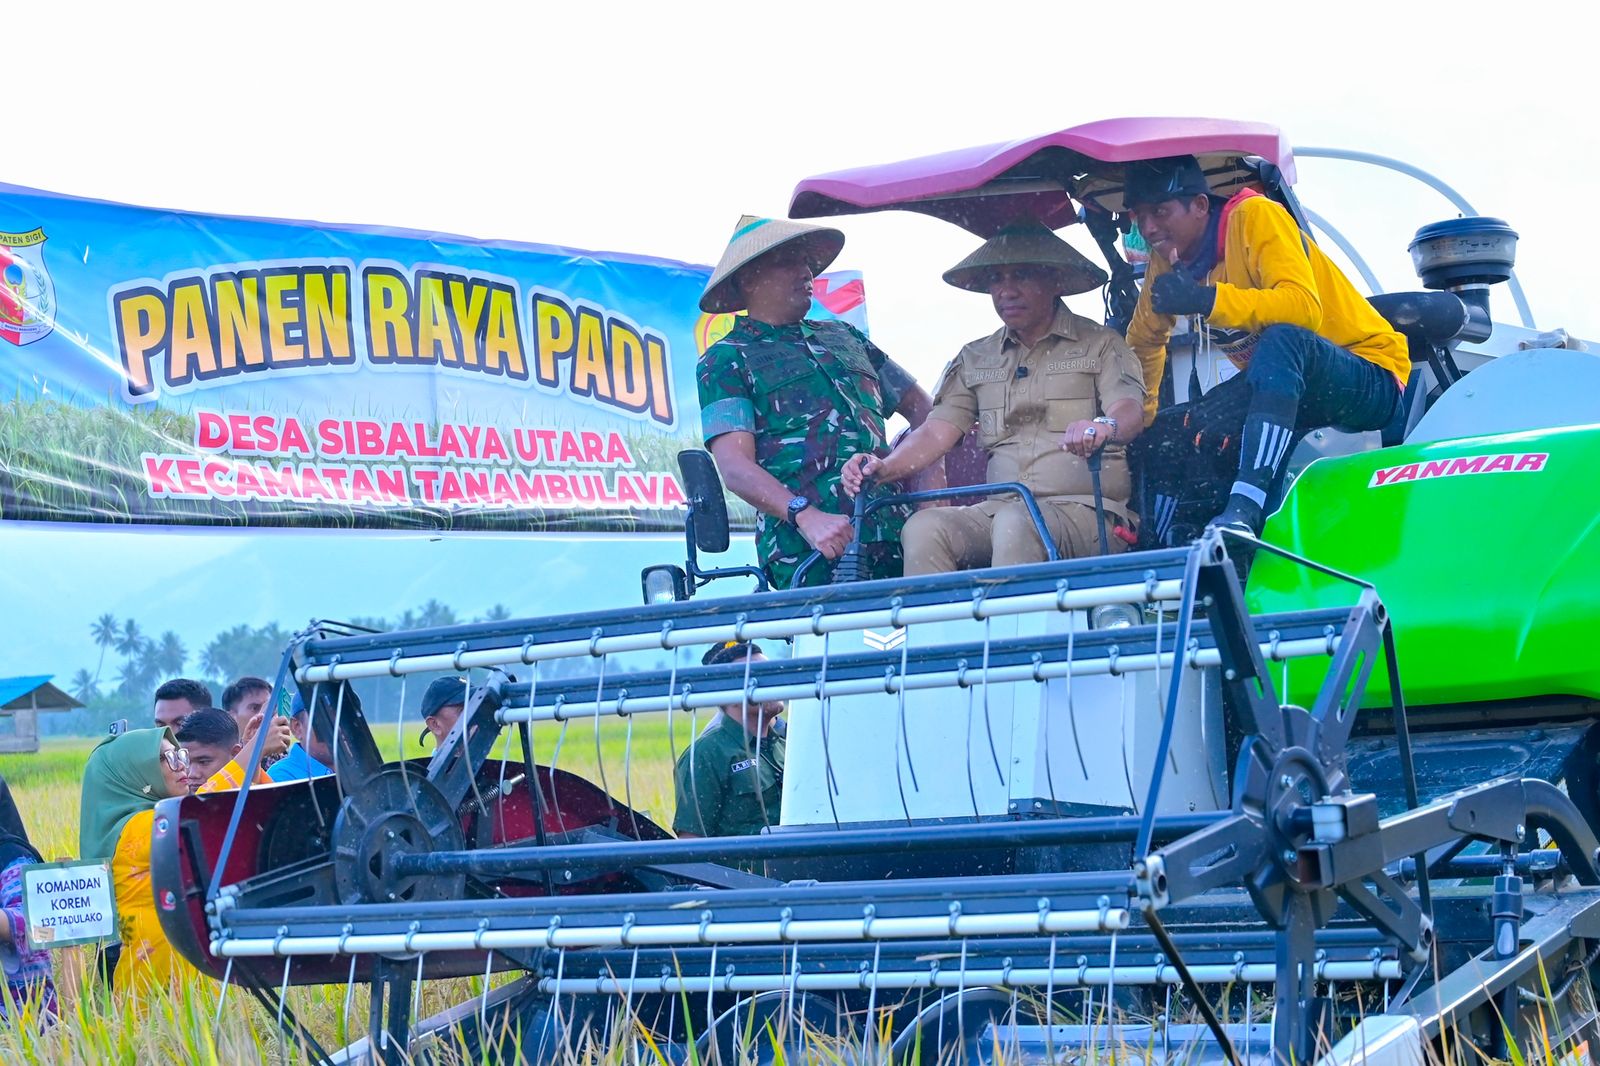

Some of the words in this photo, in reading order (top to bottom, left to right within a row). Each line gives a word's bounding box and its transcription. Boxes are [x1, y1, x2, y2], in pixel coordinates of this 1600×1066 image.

[25, 232, 41, 243] SIGI
[113, 265, 356, 396] PANEN
[362, 266, 529, 381] RAYA
[532, 293, 674, 425] PADI
[1047, 359, 1097, 371] GUBERNUR
[198, 412, 311, 453] DESA
[319, 419, 508, 459] SIBALAYA
[514, 429, 632, 464] UTARA
[1375, 454, 1547, 486] YANMAR
[145, 458, 411, 507] KECAMATAN
[415, 470, 688, 507] TANAMBULAVA
[36, 877, 101, 894] KOMANDAN
[51, 896, 91, 910] KOREM
[41, 917, 57, 927] 132
[58, 912, 103, 925] TADULAKO
